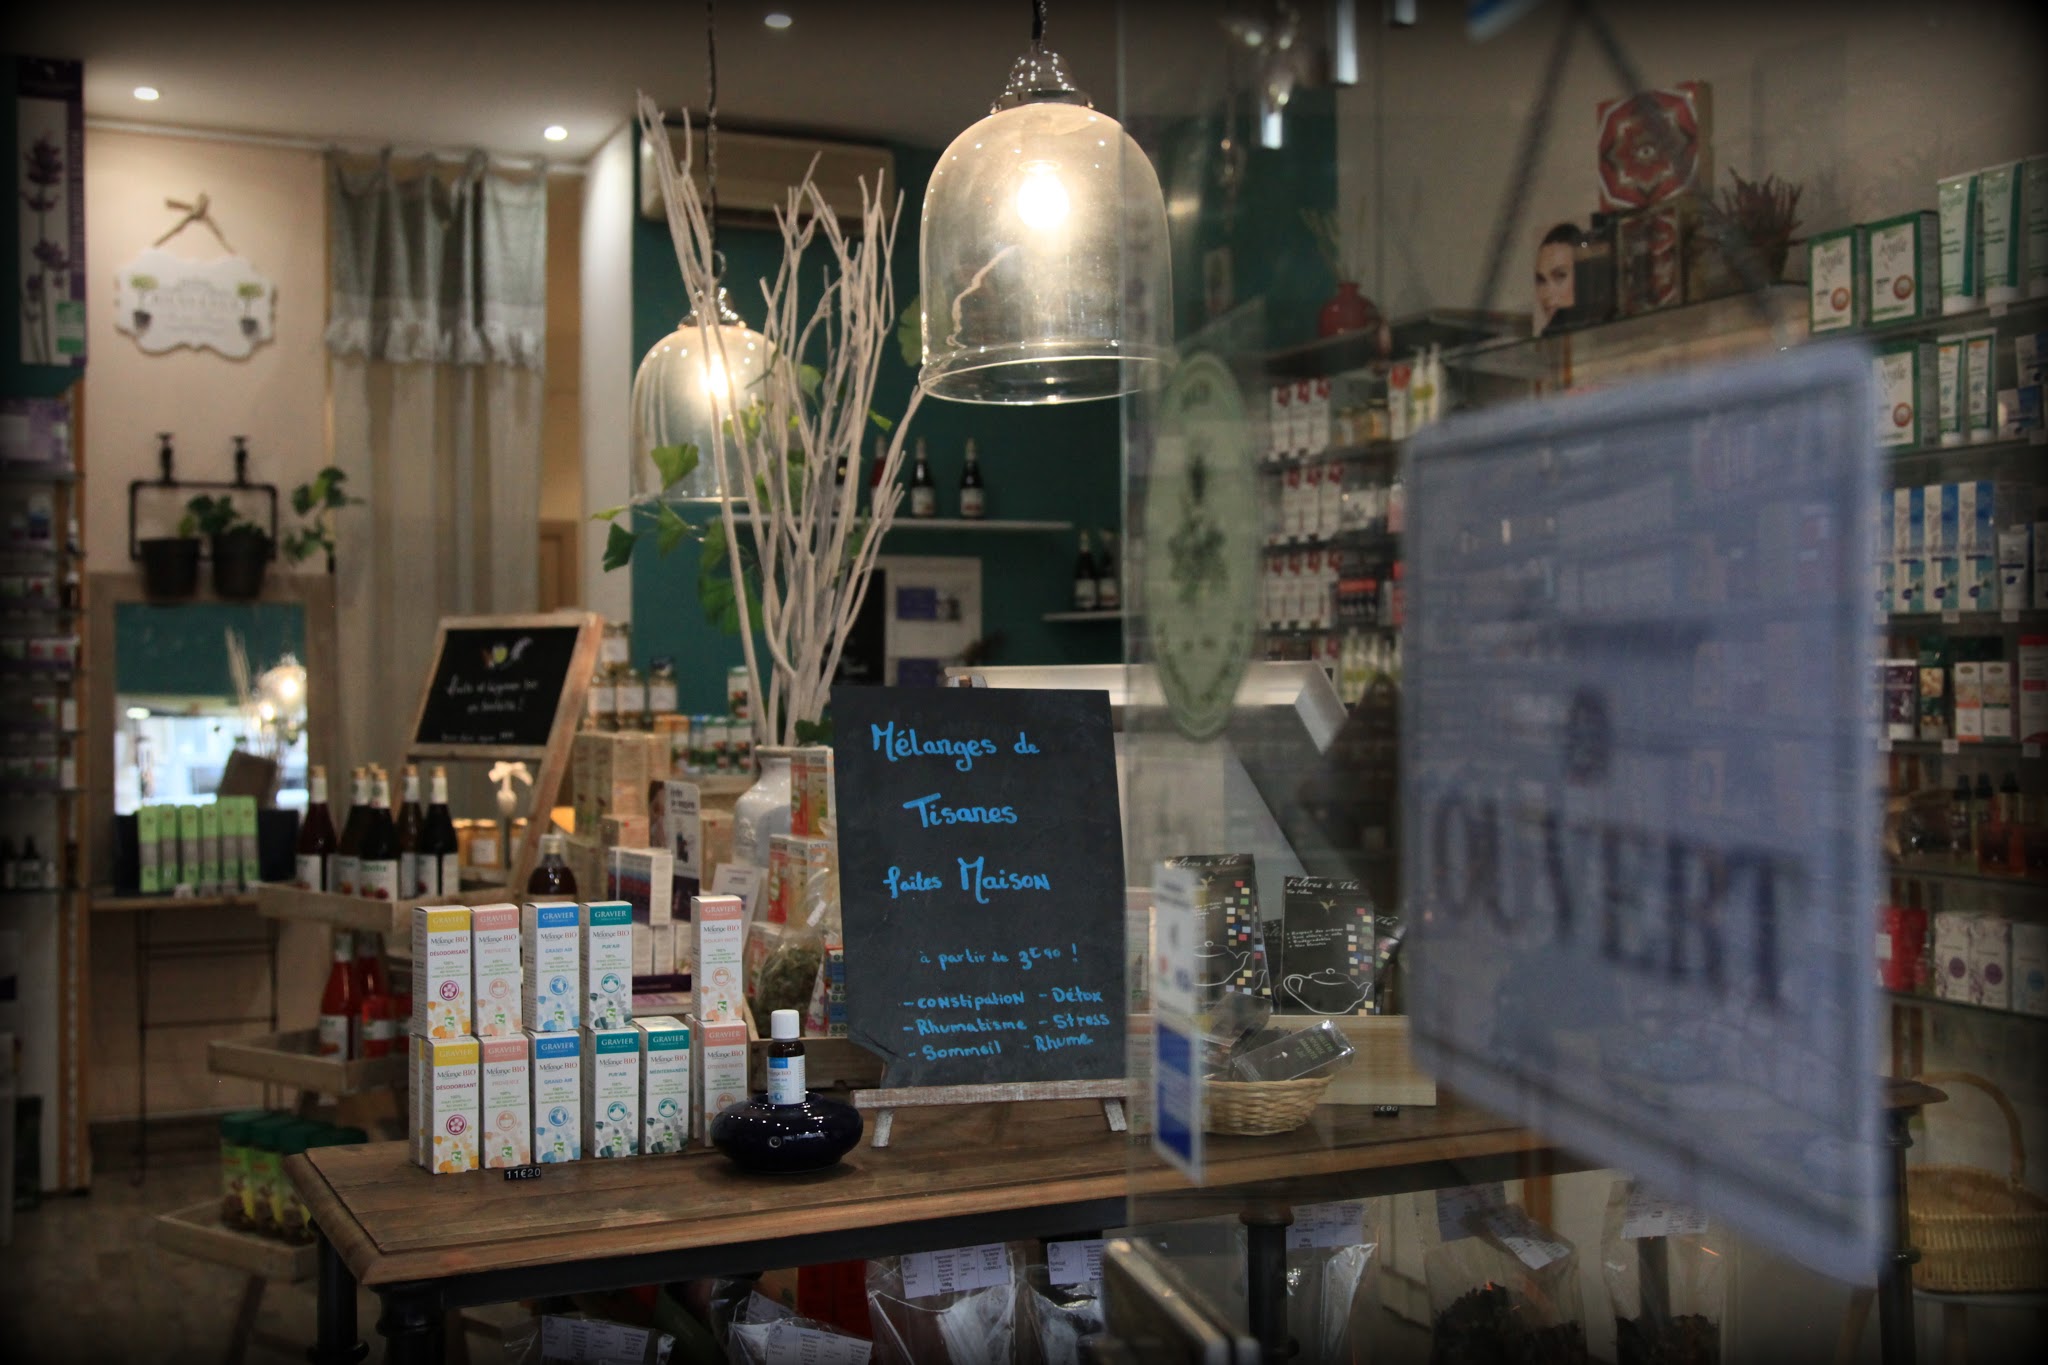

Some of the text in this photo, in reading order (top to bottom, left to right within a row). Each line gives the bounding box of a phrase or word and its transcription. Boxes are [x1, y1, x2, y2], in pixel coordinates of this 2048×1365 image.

[871, 721, 1040, 771] Mélanges de
[903, 793, 1018, 828] Tisanes
[883, 866, 942, 899] faites
[1286, 876, 1322, 889] Filtres
[1340, 879, 1360, 890] Thé
[480, 914, 513, 923] GRAVIER
[542, 911, 575, 920] GRAVIER
[594, 910, 627, 918] GRAVIER
[433, 915, 465, 924] GRAVIER
[455, 935, 468, 943] BIO
[503, 933, 517, 941] BIO
[564, 931, 577, 939] BIO
[429, 948, 469, 957] DÉSODORISANT
[919, 951, 931, 963] à
[938, 949, 985, 971] partir
[991, 950, 1009, 963] de
[1051, 987, 1103, 1003] Détox
[917, 1012, 1110, 1036] Rhumatisme Stress
[652, 1035, 684, 1043] GRAVIER
[709, 1031, 741, 1039] GRAVIER
[541, 1042, 575, 1051] GRAVIER
[601, 1038, 634, 1046] GRAVIER
[488, 1046, 521, 1055] GRAVIER
[922, 1033, 1094, 1061] Sommeil Rhume
[439, 1049, 473, 1057] GRAVIER
[435, 1082, 477, 1091] DÉSODORISANT
[506, 1167, 541, 1179] 11€20
